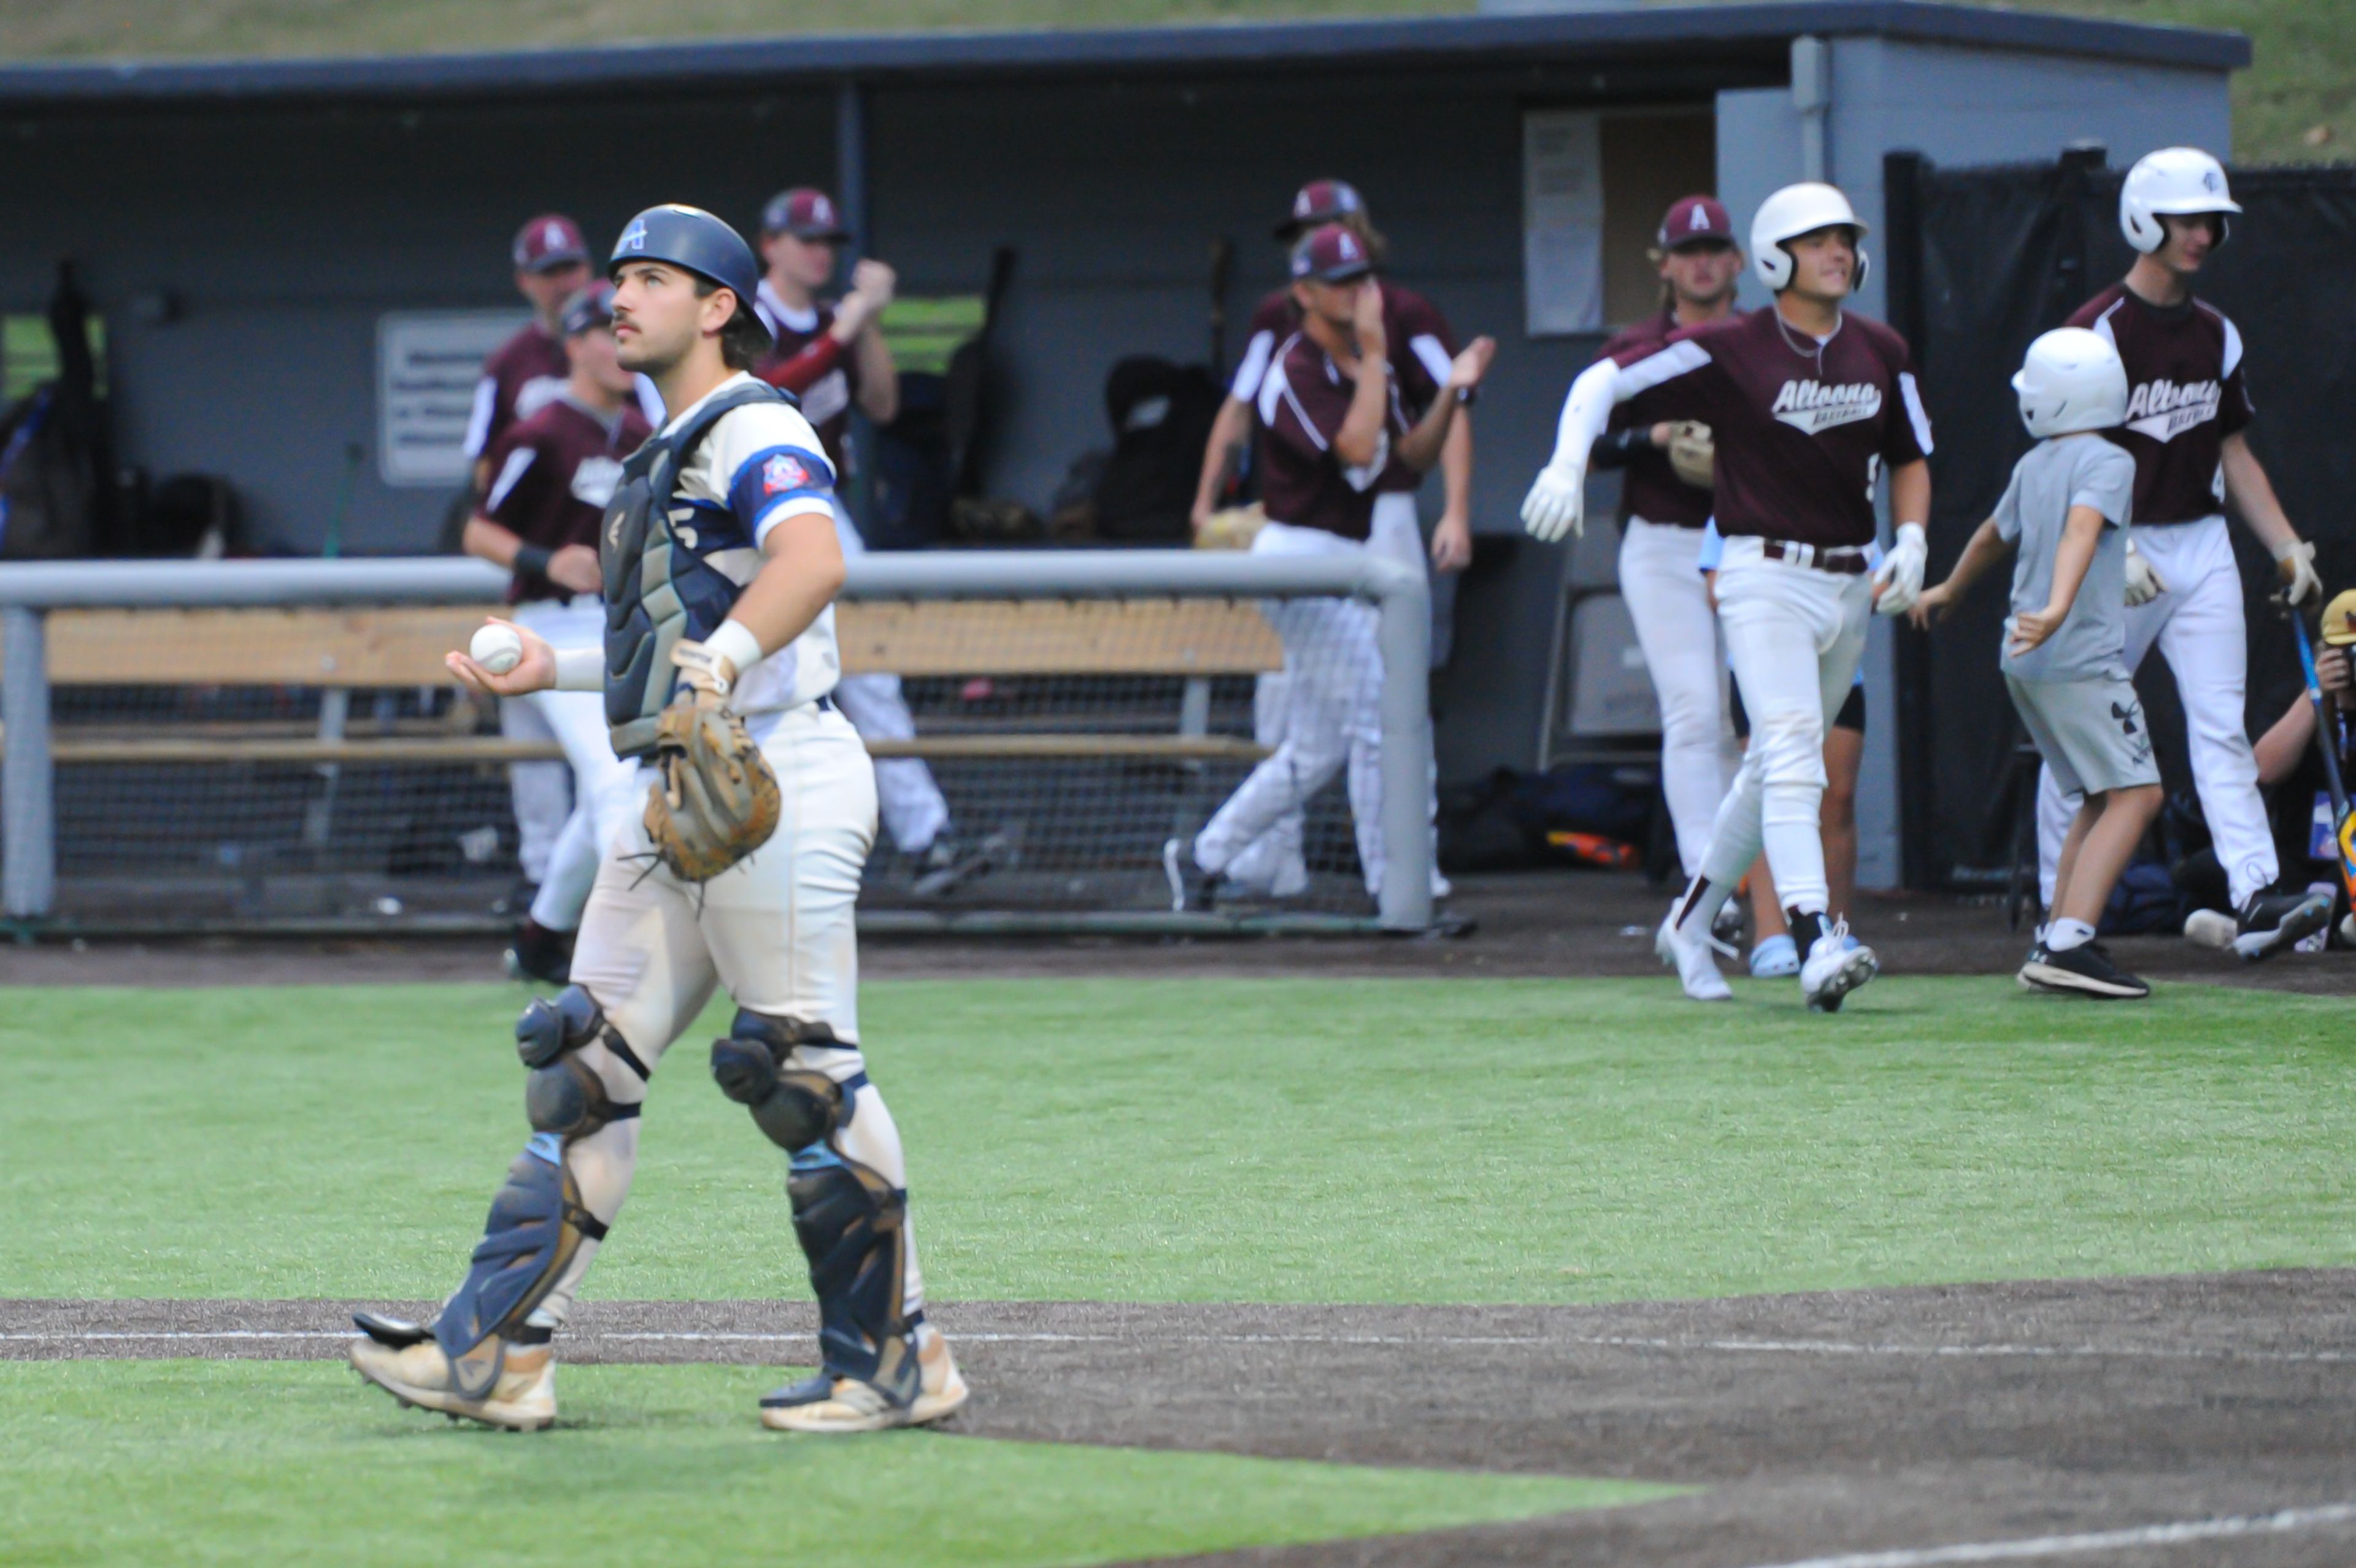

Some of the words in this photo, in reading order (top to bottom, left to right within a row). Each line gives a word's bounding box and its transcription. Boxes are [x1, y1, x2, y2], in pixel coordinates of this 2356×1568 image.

[1690, 203, 1710, 231] A
[616, 218, 648, 254] A
[1339, 232, 1358, 260] A
